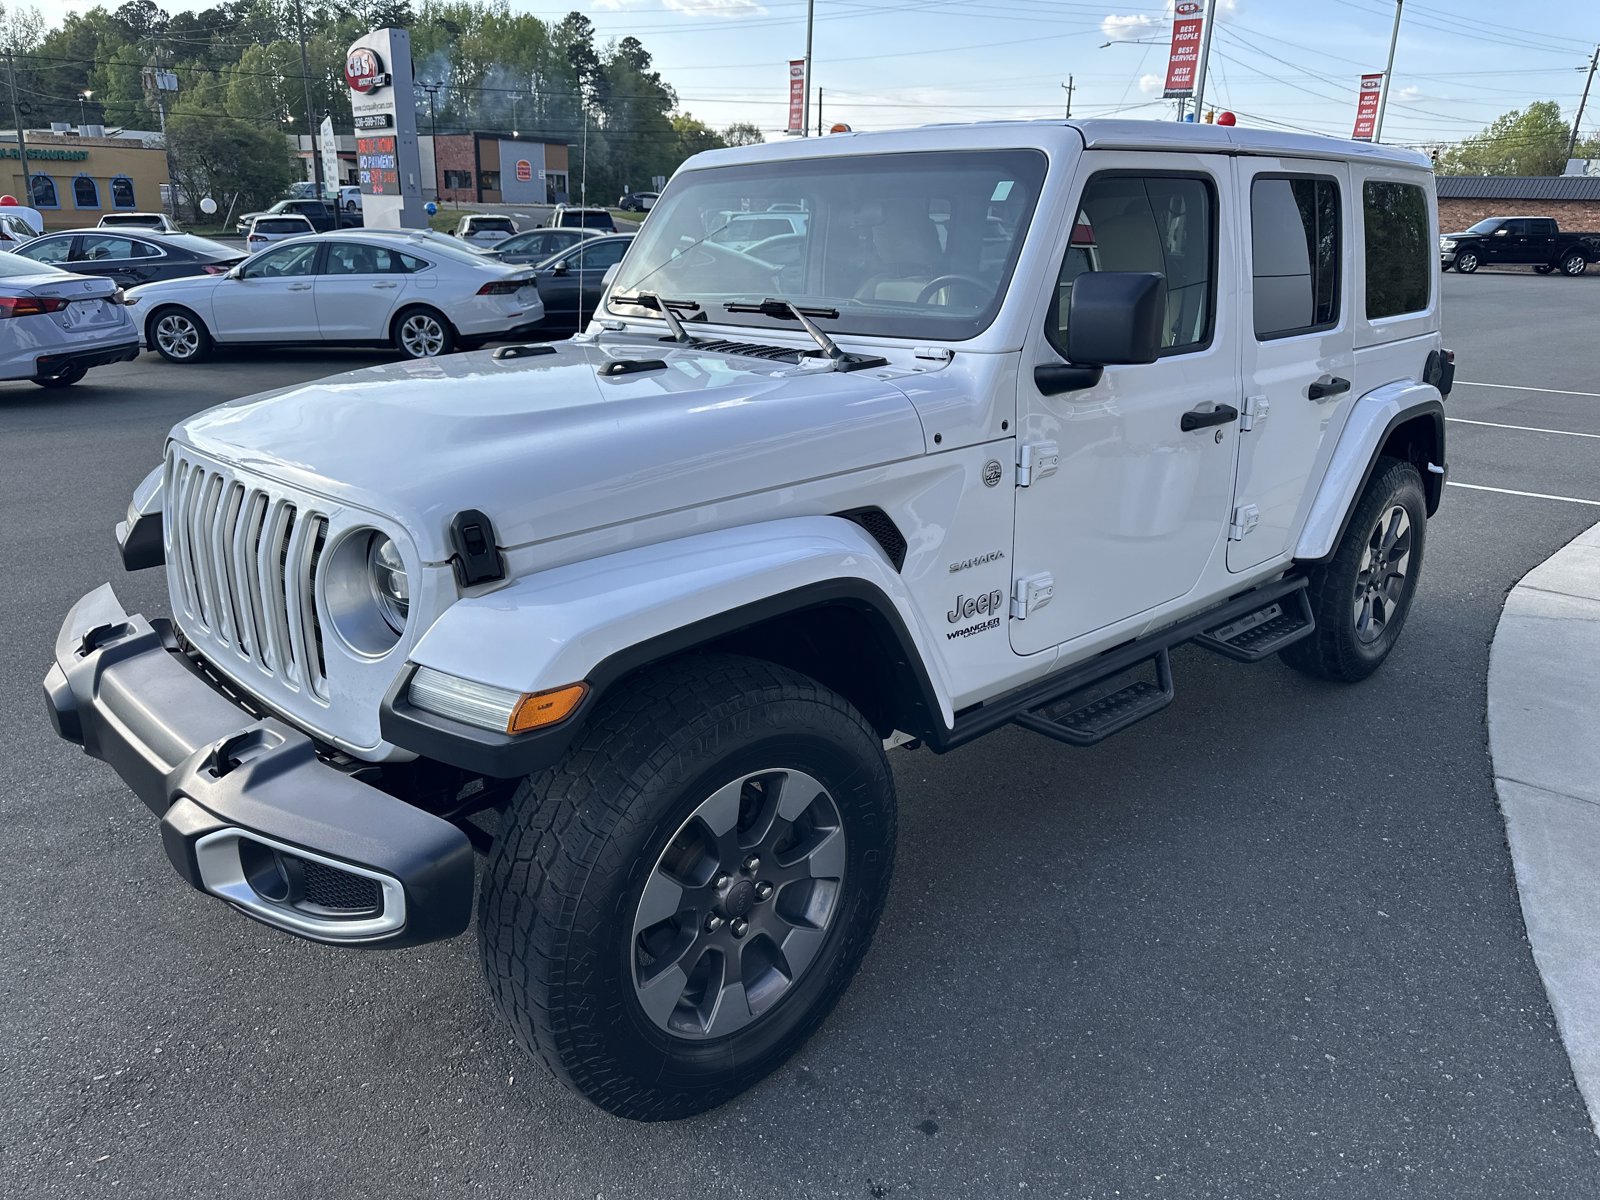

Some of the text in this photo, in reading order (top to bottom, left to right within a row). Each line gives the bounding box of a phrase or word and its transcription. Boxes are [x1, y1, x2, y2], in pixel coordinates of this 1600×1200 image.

[1178, 4, 1196, 12] CBS
[1180, 25, 1196, 33] BEST
[1175, 33, 1199, 41] PEOPLE
[1177, 46, 1194, 54] BEST
[1171, 54, 1197, 62] SERVICE
[348, 55, 370, 77] CBS
[1174, 67, 1191, 75] BEST
[10, 148, 89, 160] RSTAURANT
[949, 550, 1005, 574] SAHARA
[947, 589, 1003, 624] Jeep
[946, 617, 1001, 640] WRANGLER
[963, 623, 1001, 638] UNLIMITED
